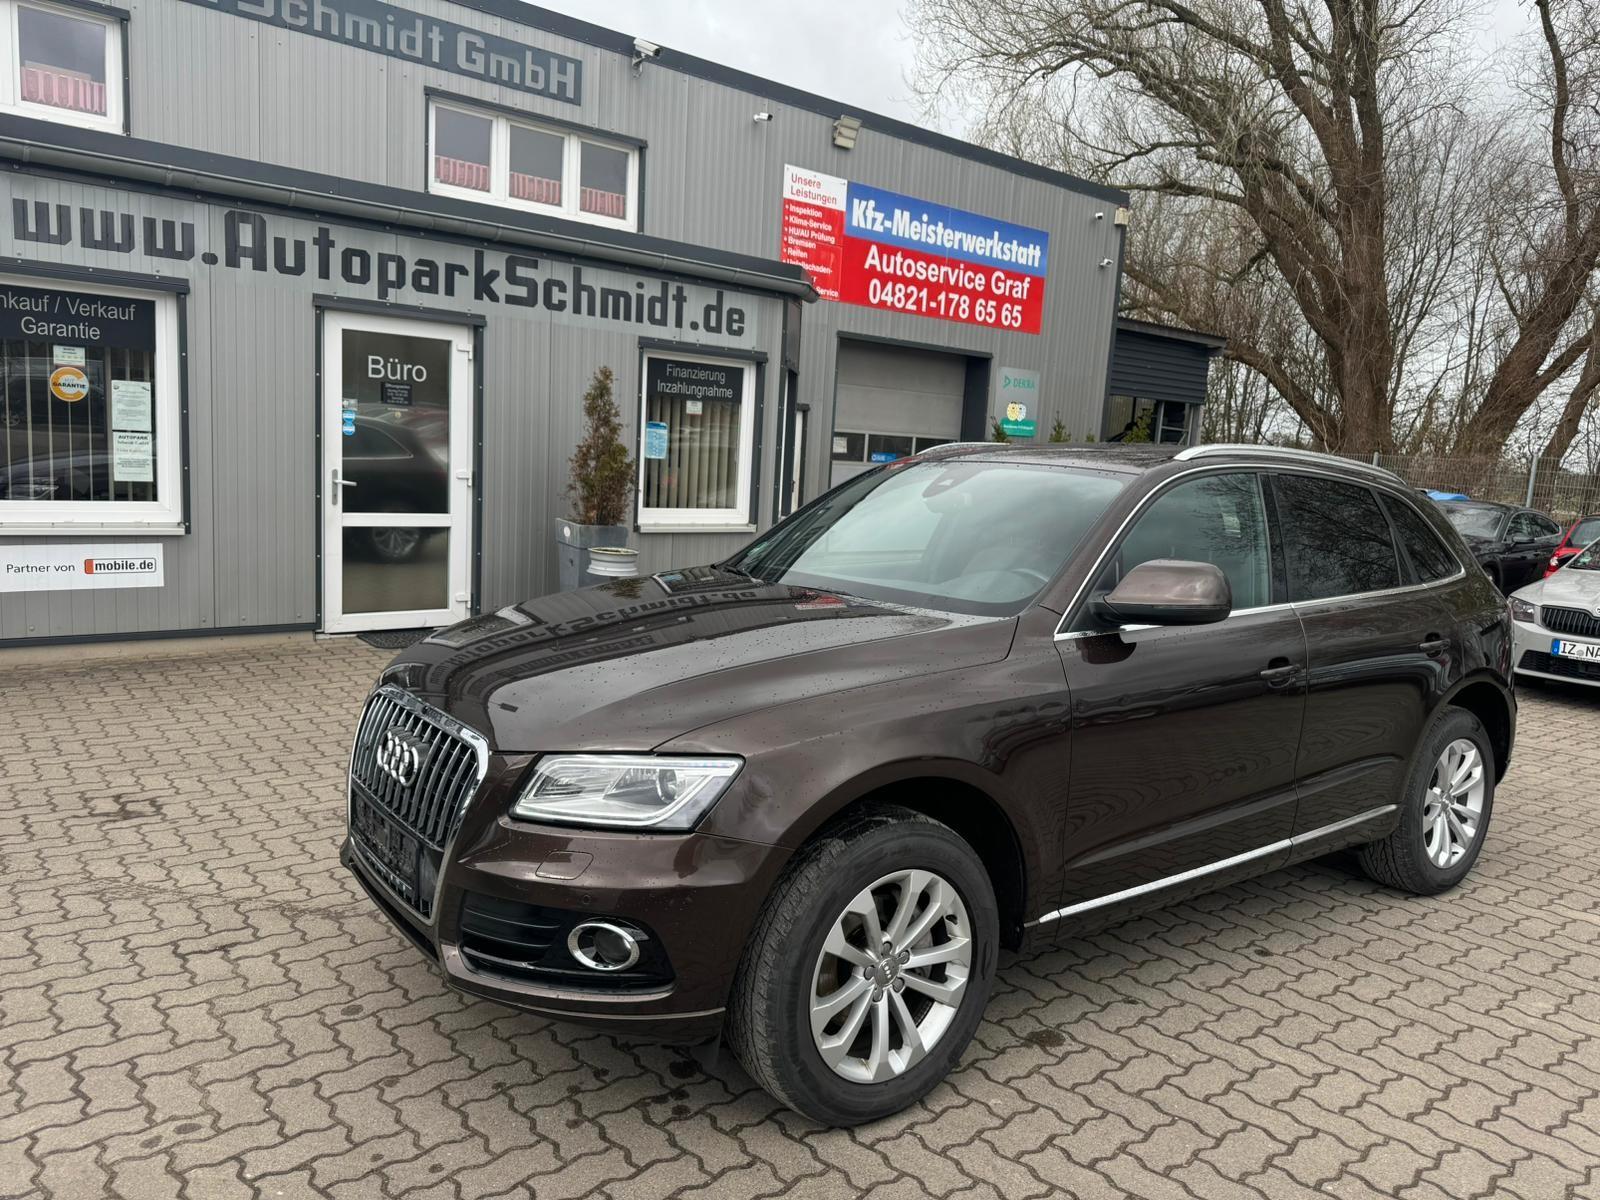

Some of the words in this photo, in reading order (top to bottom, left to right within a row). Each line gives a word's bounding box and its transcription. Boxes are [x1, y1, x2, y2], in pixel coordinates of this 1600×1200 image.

[456, 31, 576, 99] GmbH
[791, 172, 822, 189] Unsere
[790, 186, 837, 206] Leistungen
[789, 203, 823, 219] Inspektion
[788, 214, 833, 231] Klima-Service
[851, 198, 1042, 268] Kfz-Meisterwerkstatt
[787, 236, 817, 250] Bremsen
[810, 229, 836, 245] Prüfung
[13, 199, 745, 337] www.AutoparkSchmidt.de
[864, 244, 986, 291] Autoservice
[991, 270, 1031, 300] Graf
[66, 297, 137, 321] Verkauf
[868, 278, 970, 320] 04821-178
[974, 298, 997, 324] 65
[1001, 302, 1023, 328] 65
[21, 316, 101, 340] Garantie
[367, 355, 427, 382] Büro
[666, 363, 726, 385] Finanzierung
[657, 379, 733, 399] Inzahlungnahme
[6, 563, 51, 574] Partner
[54, 563, 76, 573] von
[95, 560, 154, 571] mobile.de
[1561, 642, 1577, 656] IZ
